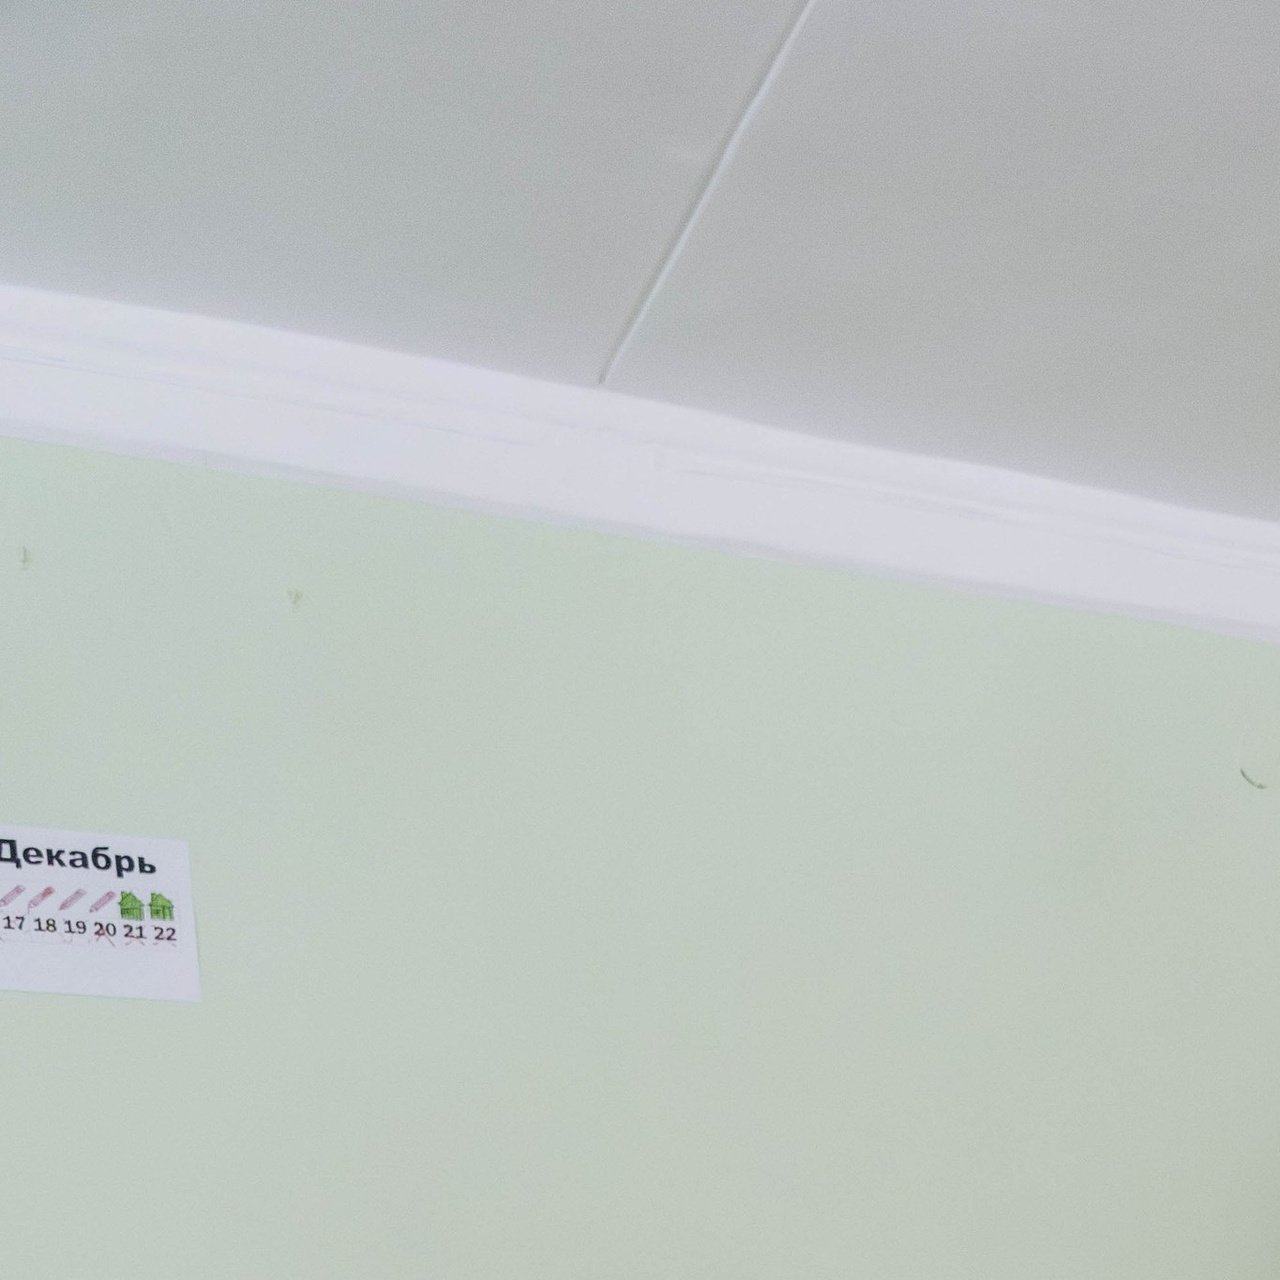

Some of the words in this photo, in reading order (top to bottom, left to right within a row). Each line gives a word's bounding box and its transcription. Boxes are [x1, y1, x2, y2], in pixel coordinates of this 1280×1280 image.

[0, 839, 156, 878] Декабрь
[3, 916, 25, 930] 17
[33, 918, 57, 932] 18
[63, 920, 87, 934] 19
[93, 922, 117, 936] 20
[123, 924, 147, 939] 21
[153, 926, 177, 941] 22
